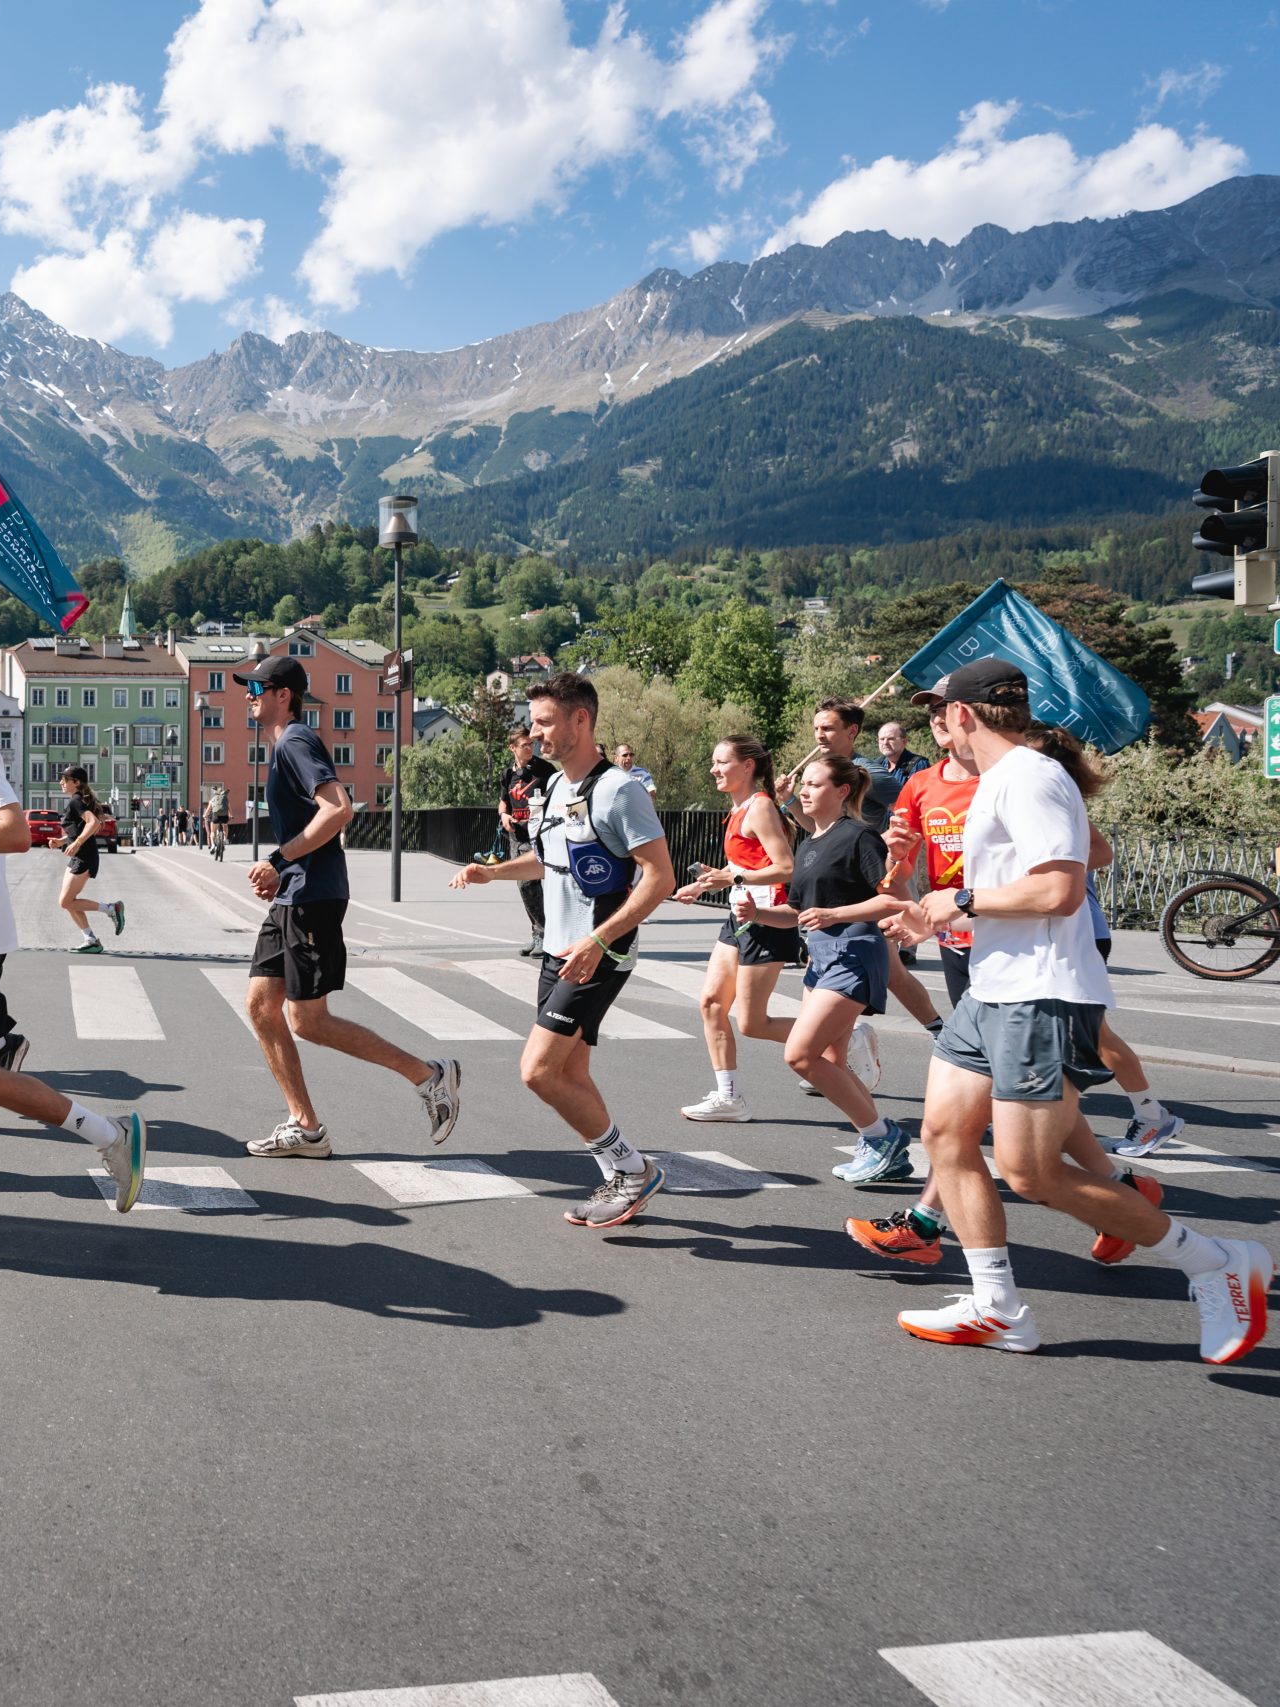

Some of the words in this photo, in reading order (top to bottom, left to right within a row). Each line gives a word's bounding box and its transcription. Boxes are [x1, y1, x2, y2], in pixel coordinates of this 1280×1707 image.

[928, 818, 948, 826] 2023
[940, 844, 964, 852] KRE
[552, 1012, 575, 1024] TERREX
[1225, 1272, 1252, 1324] TERREX
